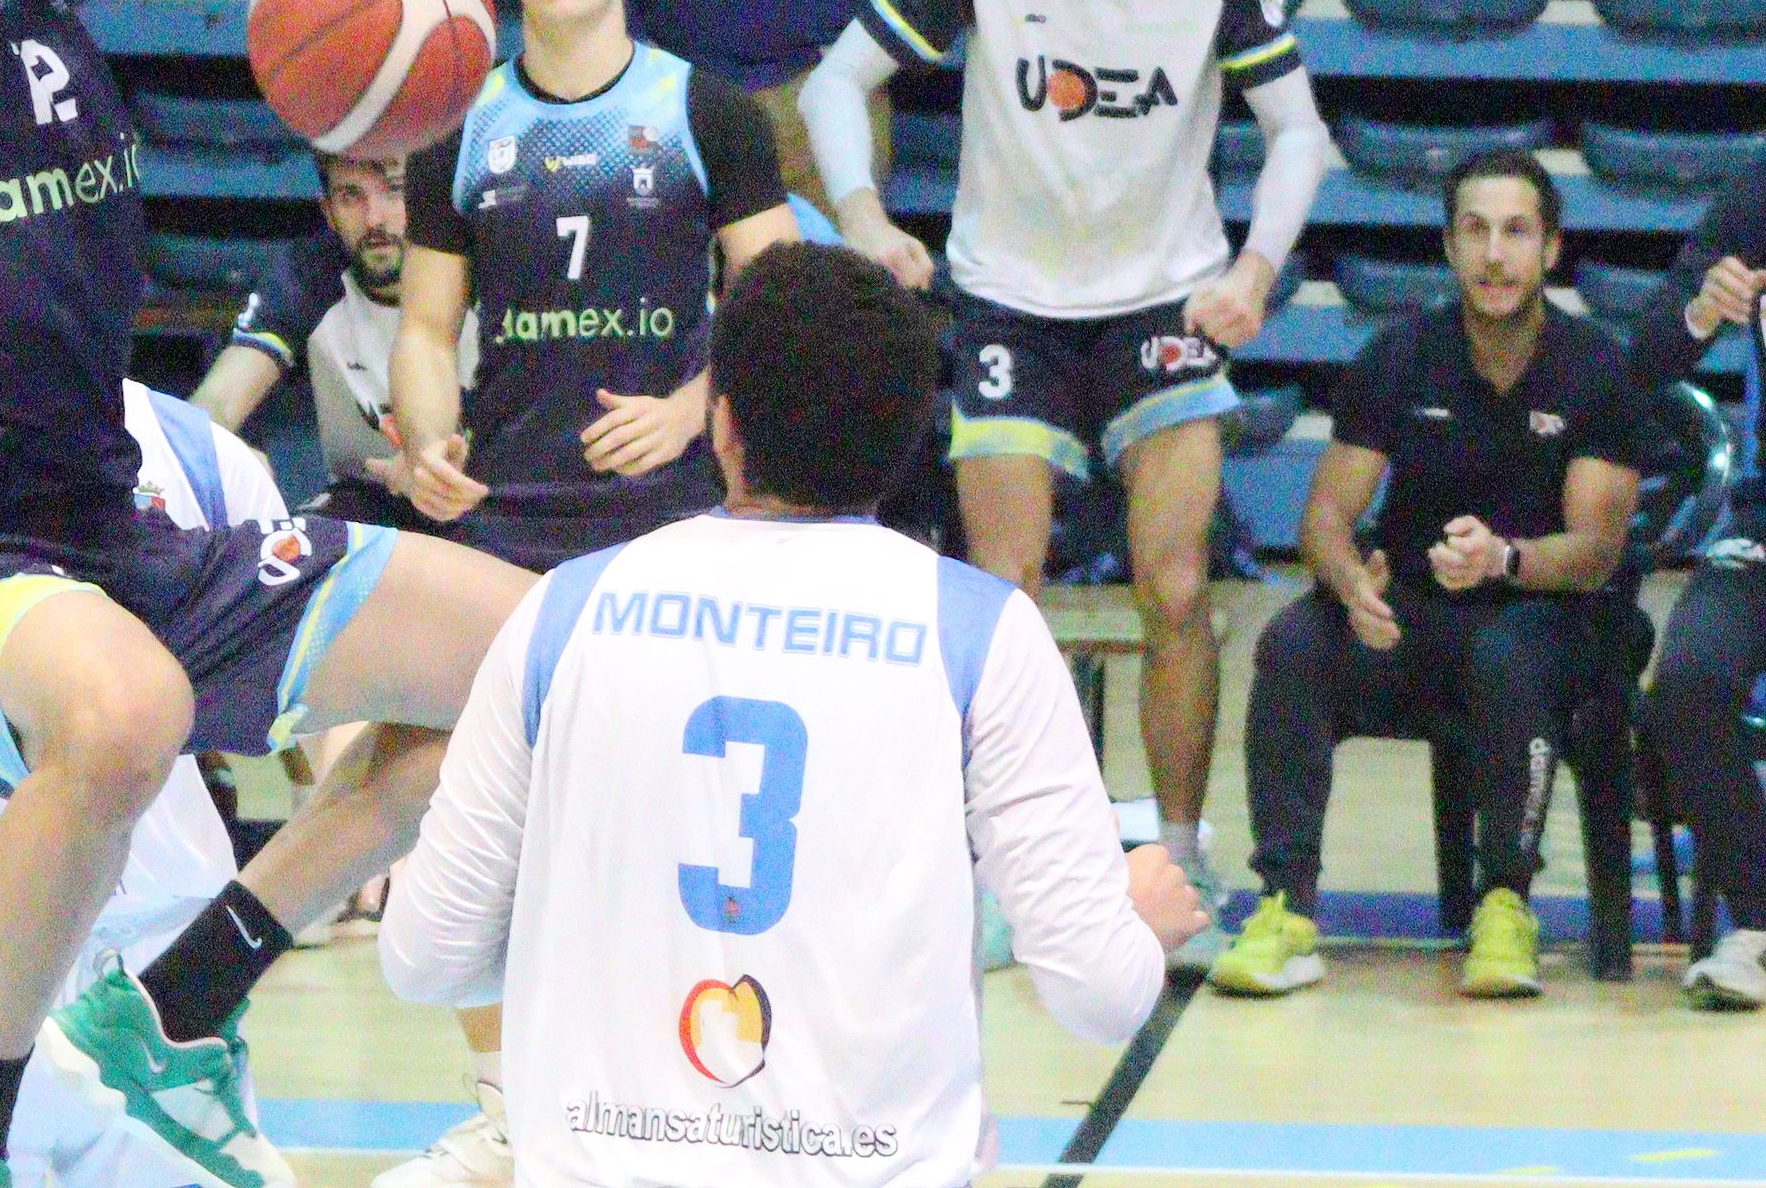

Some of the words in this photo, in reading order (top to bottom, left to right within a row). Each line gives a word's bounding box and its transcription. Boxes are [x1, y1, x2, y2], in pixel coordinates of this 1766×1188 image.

[1015, 54, 1178, 122] UDEA
[556, 214, 590, 280] 7
[978, 343, 1012, 399] 3
[591, 589, 930, 667] MONTEIRO
[677, 694, 809, 936] 3
[565, 1091, 900, 1159] almansaturistica.es
